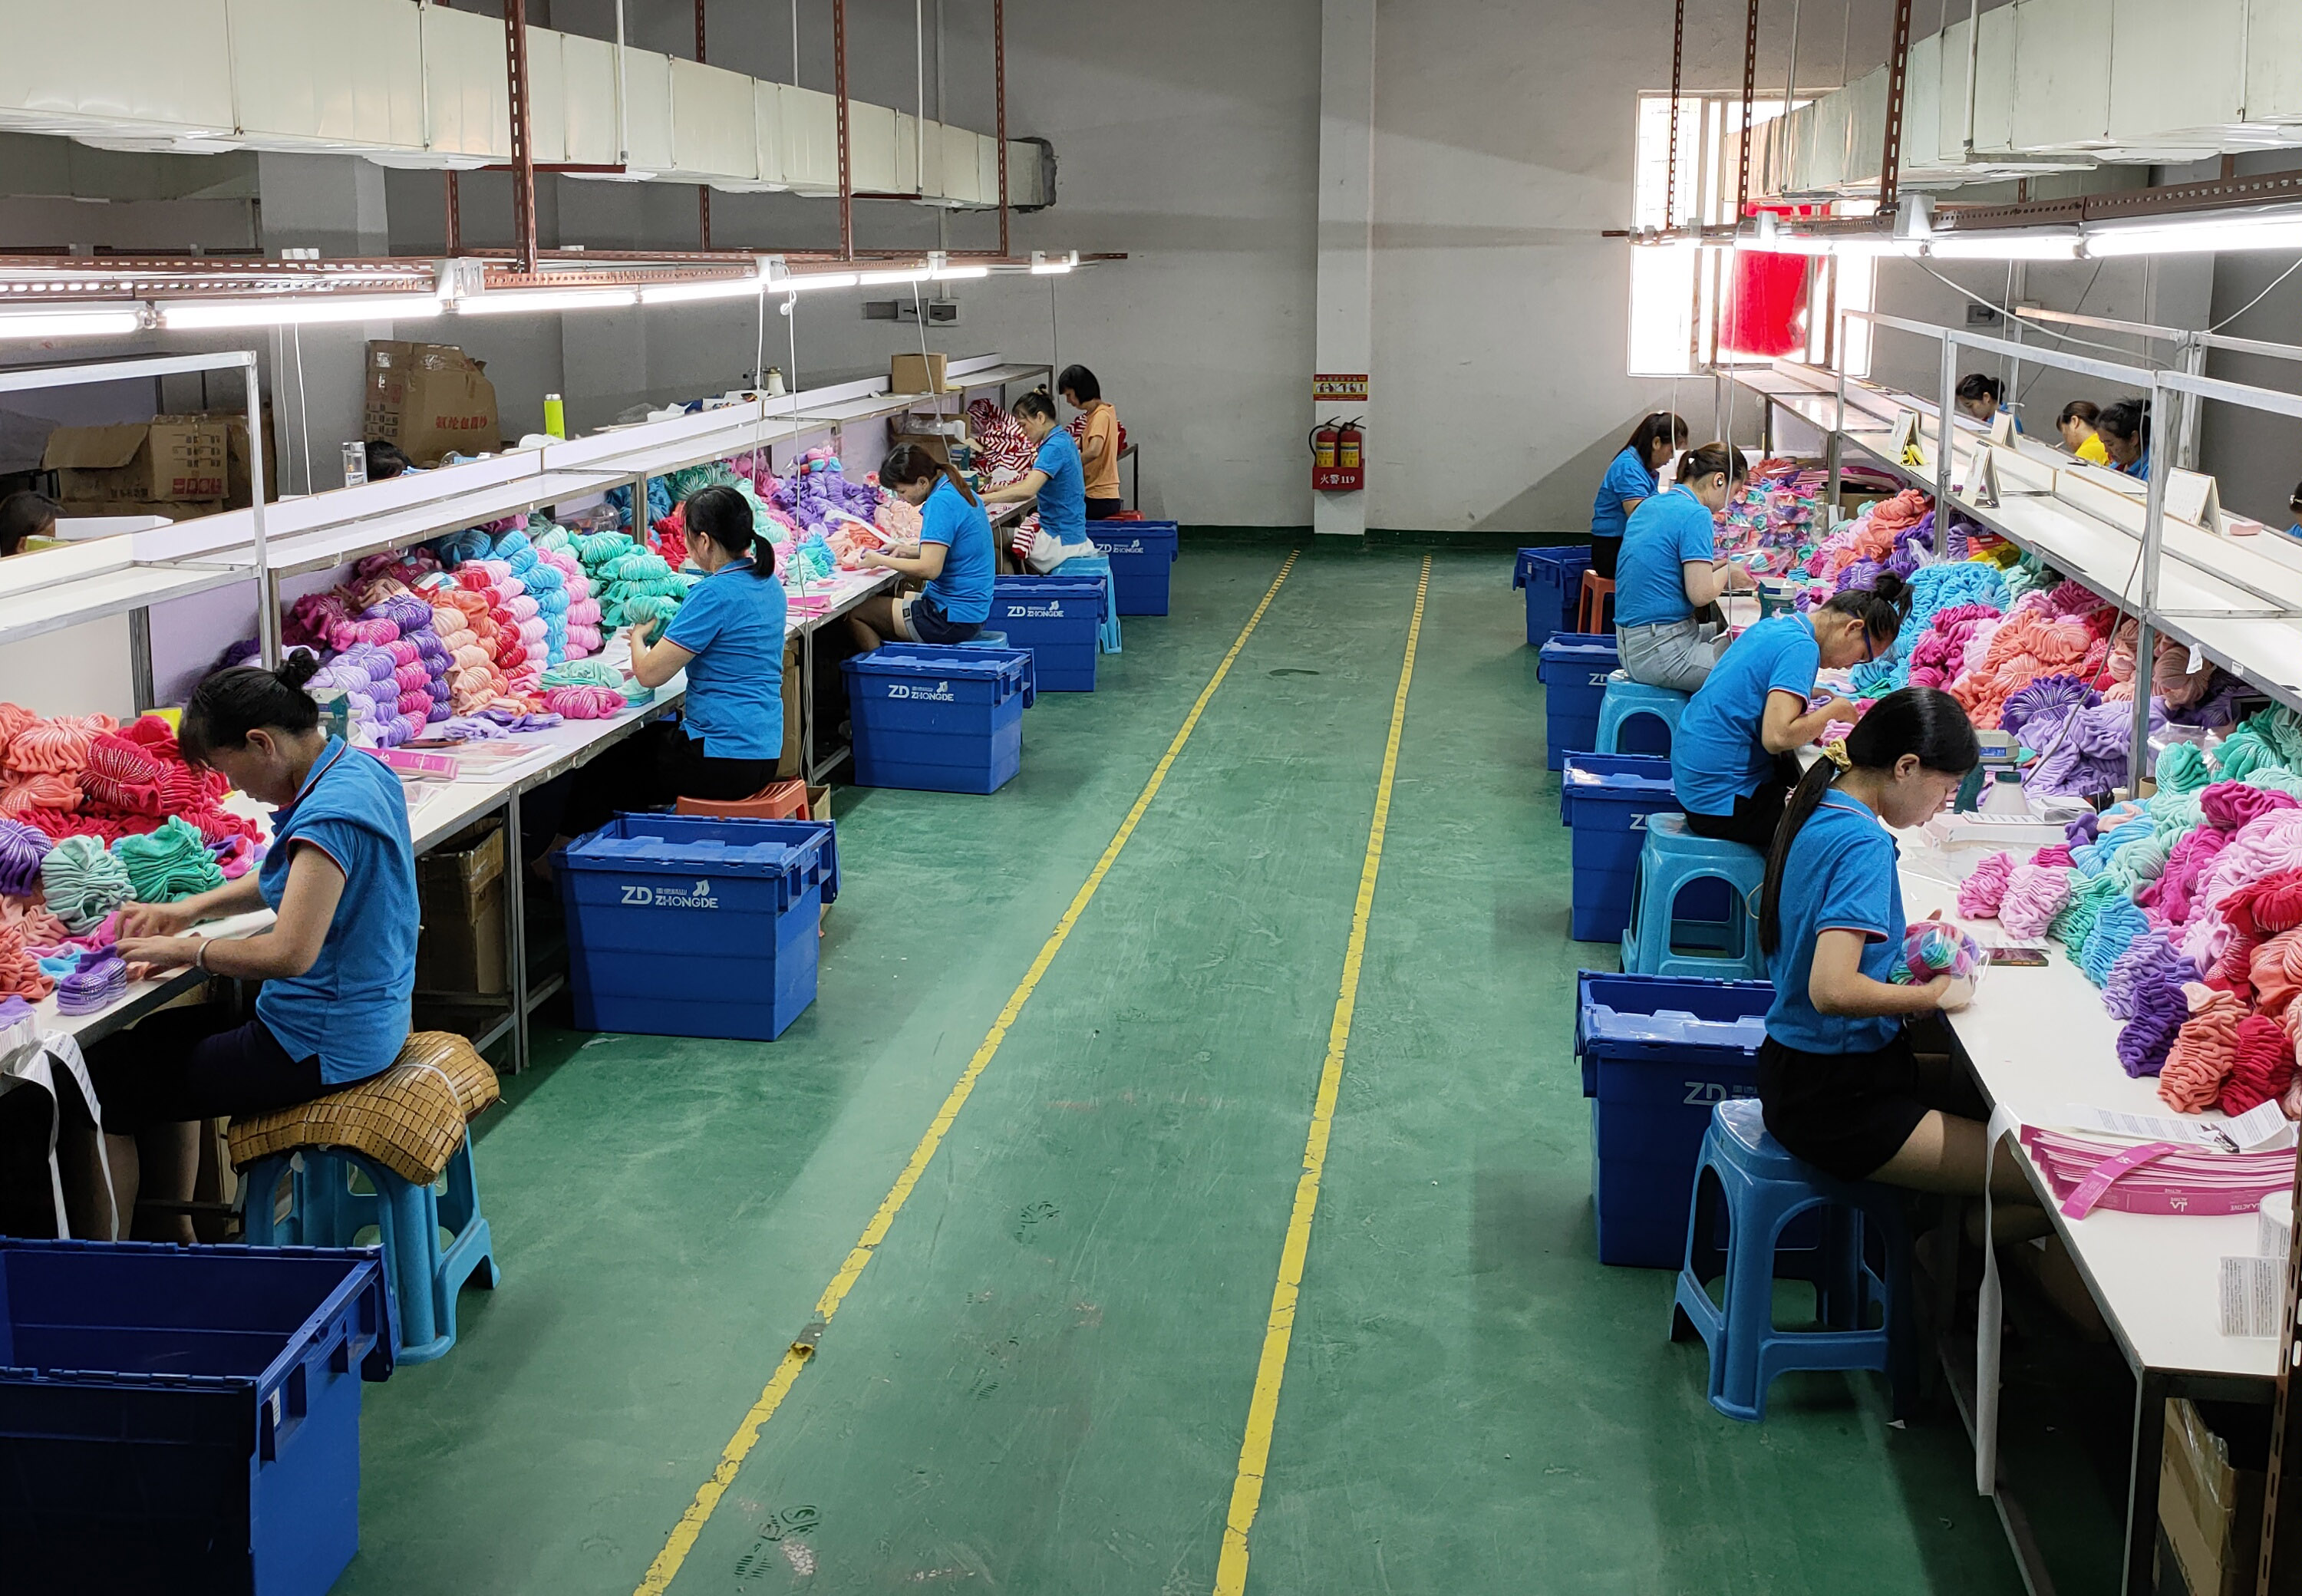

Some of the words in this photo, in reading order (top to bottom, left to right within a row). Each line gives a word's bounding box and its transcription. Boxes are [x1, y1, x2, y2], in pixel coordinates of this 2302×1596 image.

[1320, 474, 1340, 484] 火警
[1008, 606, 1026, 617] ZD
[889, 684, 909, 698] ZD
[911, 691, 954, 701] ZHONGDE
[621, 885, 652, 905] ZD
[655, 895, 718, 908] ZHONGDE
[1684, 1081, 1726, 1106] ZD
